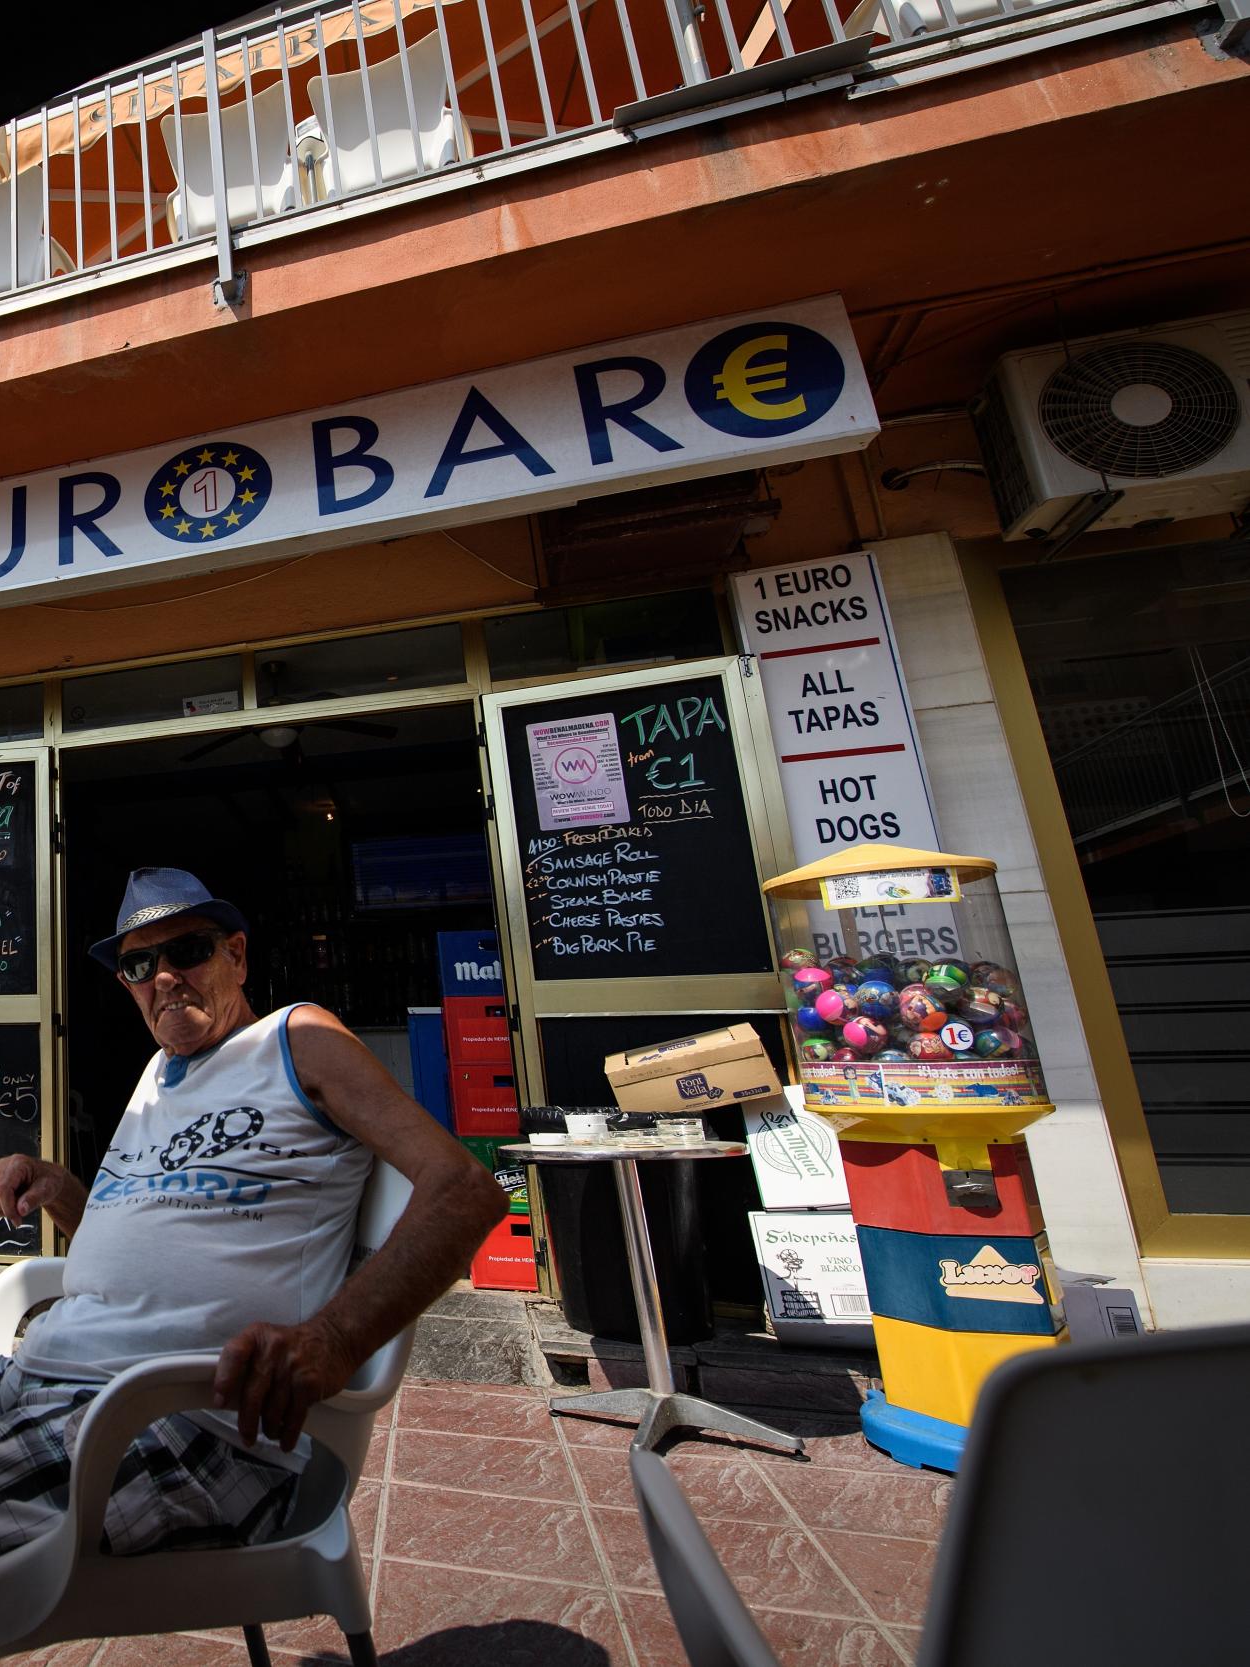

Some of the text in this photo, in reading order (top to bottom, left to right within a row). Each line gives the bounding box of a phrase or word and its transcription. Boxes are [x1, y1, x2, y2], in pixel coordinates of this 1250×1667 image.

[311, 356, 685, 517] BAR
[754, 564, 852, 600] 1 EURO
[755, 596, 868, 634] SNACKS
[802, 669, 855, 698] ALL
[620, 696, 726, 746] TAPA
[788, 701, 880, 735] TAPAS
[627, 749, 654, 768] from
[646, 752, 706, 790] €1
[7, 774, 22, 796] of
[818, 775, 877, 805] HOT
[638, 803, 672, 818] TODO
[563, 831, 602, 846] FRESH
[815, 812, 901, 844] DOGS
[541, 852, 613, 874] SAUSAGE
[546, 875, 607, 890] CORNISH
[608, 868, 662, 887] PASTIE
[602, 888, 653, 905] BAKE
[605, 908, 665, 928] PASTIES
[580, 935, 624, 954] PORK
[627, 931, 659, 952] PIE
[812, 926, 958, 959] BURGERS
[948, 1026, 969, 1046] 1€
[2, 1074, 35, 1085] ONLY
[679, 1076, 704, 1089] Font
[681, 1085, 708, 1097] Vella
[786, 1134, 826, 1177] Miguel
[821, 1264, 862, 1273] BLANCO
[826, 1256, 853, 1265] VINO
